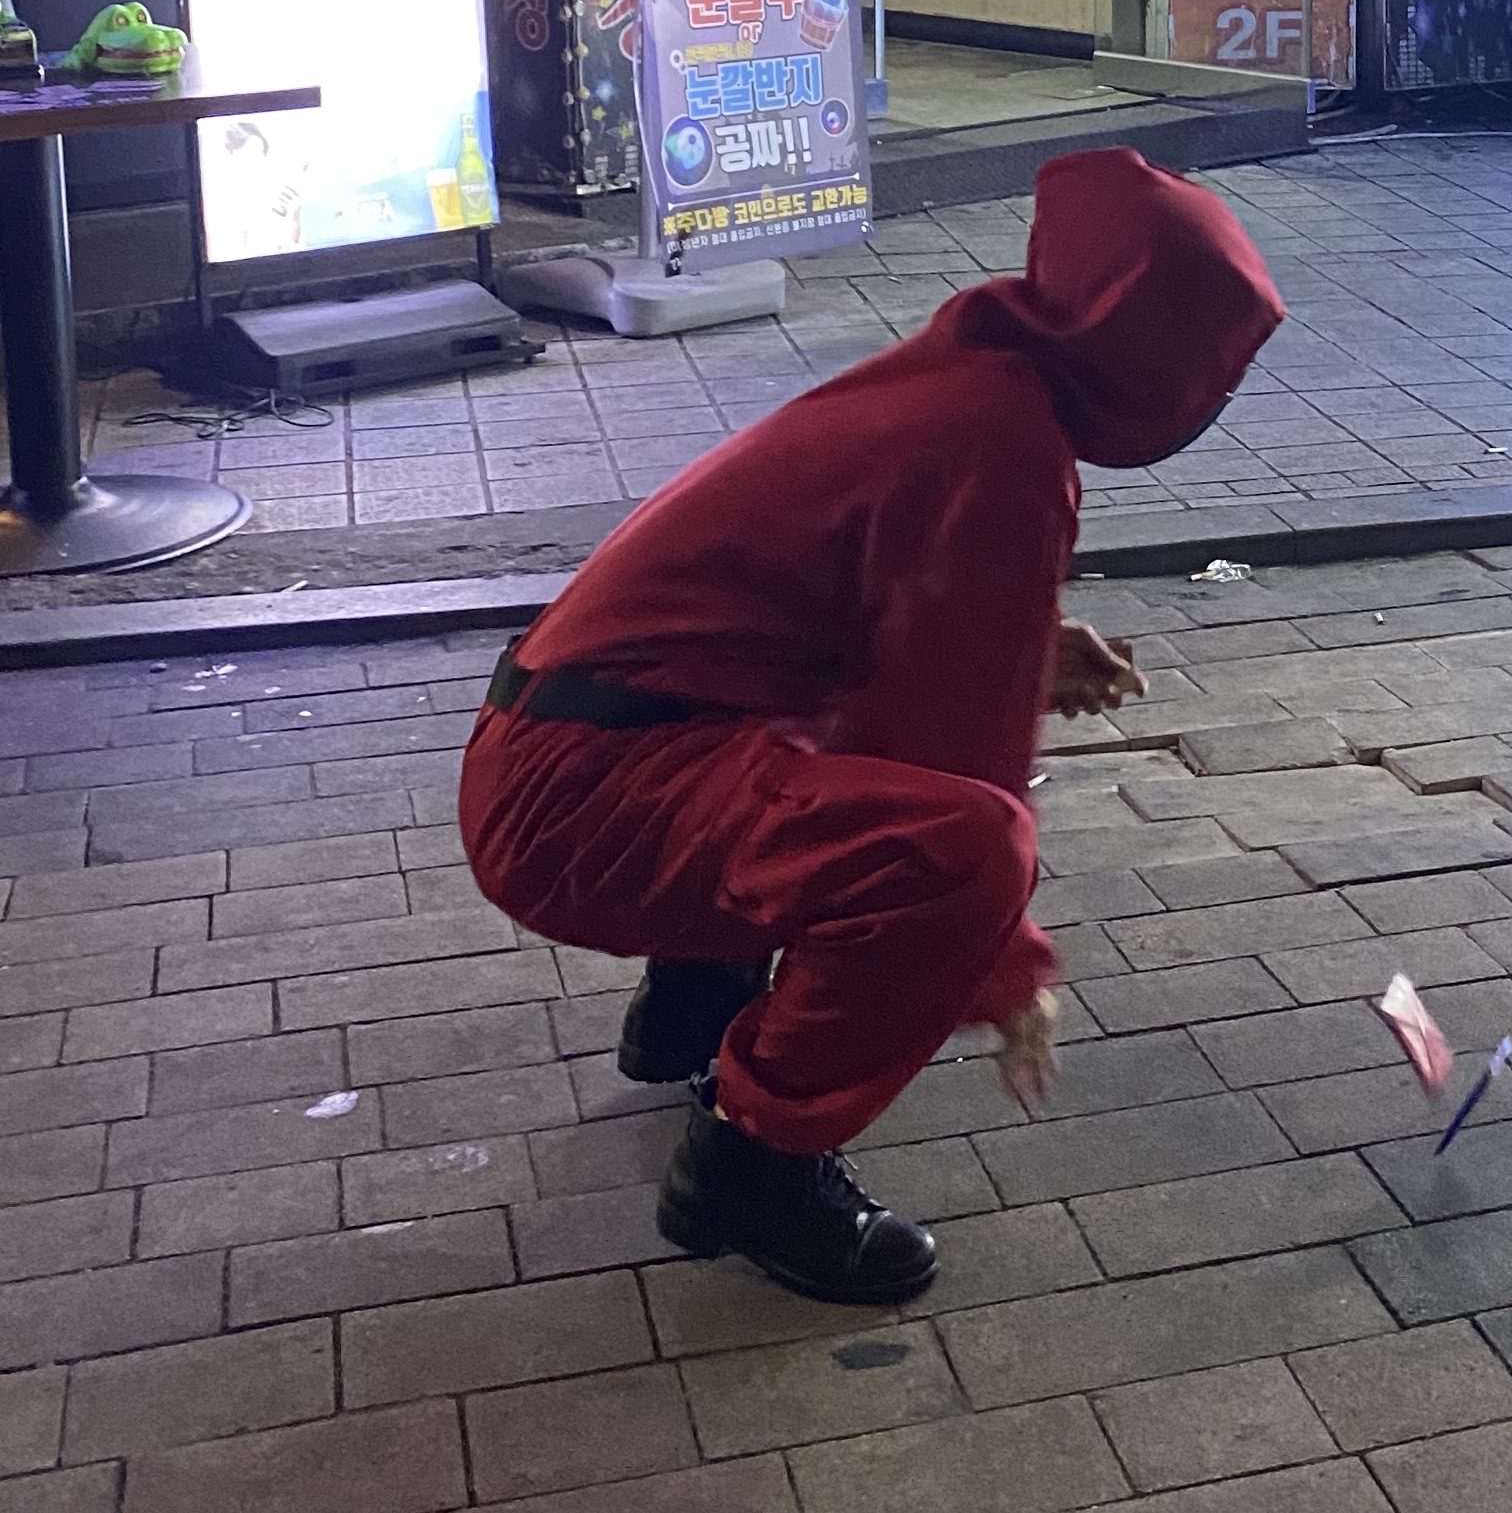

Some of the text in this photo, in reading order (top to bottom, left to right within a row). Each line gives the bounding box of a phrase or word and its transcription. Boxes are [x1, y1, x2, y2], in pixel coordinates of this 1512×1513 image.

[739, 22, 762, 43] or
[1215, 9, 1304, 61] 2F
[686, 53, 823, 120] 눈깔반지
[715, 117, 812, 172] 공짜!!
[810, 186, 867, 212] 교환가능
